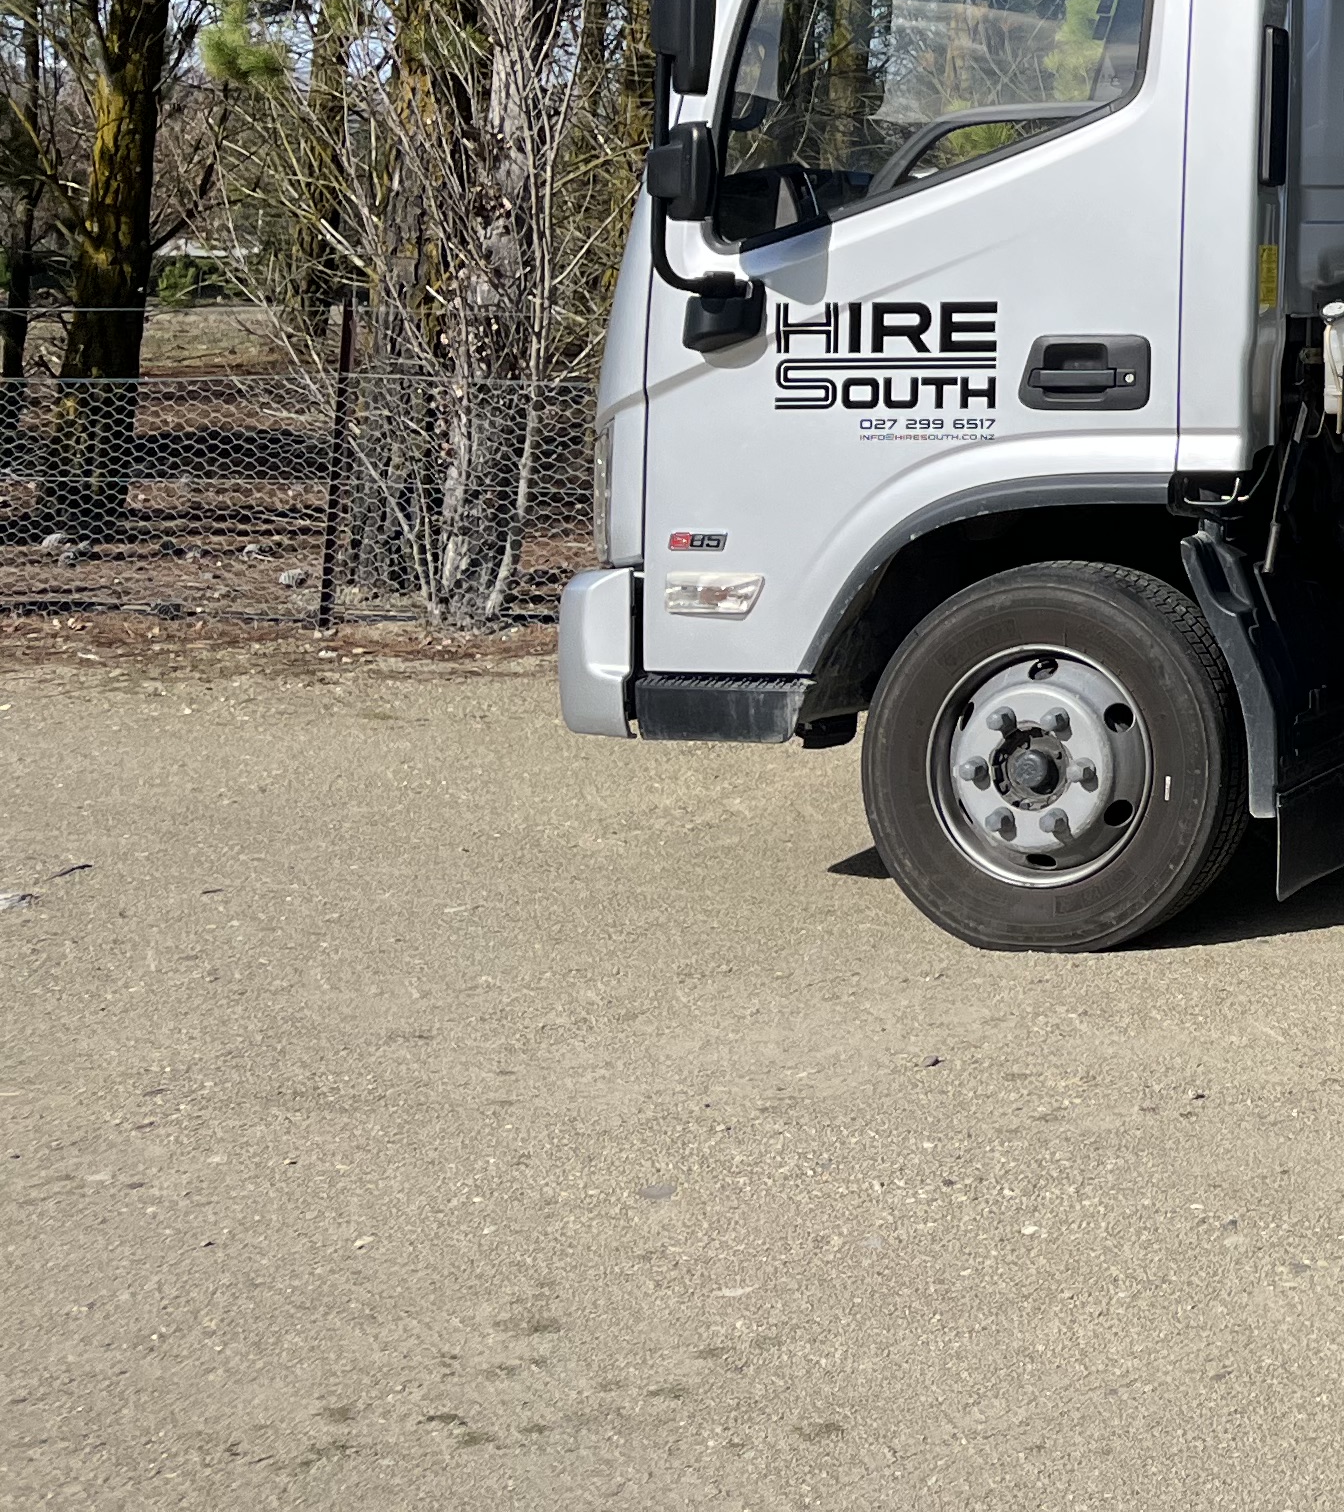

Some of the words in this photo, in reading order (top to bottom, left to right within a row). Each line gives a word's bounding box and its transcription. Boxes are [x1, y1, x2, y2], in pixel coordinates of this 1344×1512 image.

[776, 301, 998, 353] HIRE
[774, 356, 996, 409] SOUTH
[859, 418, 897, 430] 027
[905, 418, 944, 430] 299
[952, 418, 996, 430] 6517
